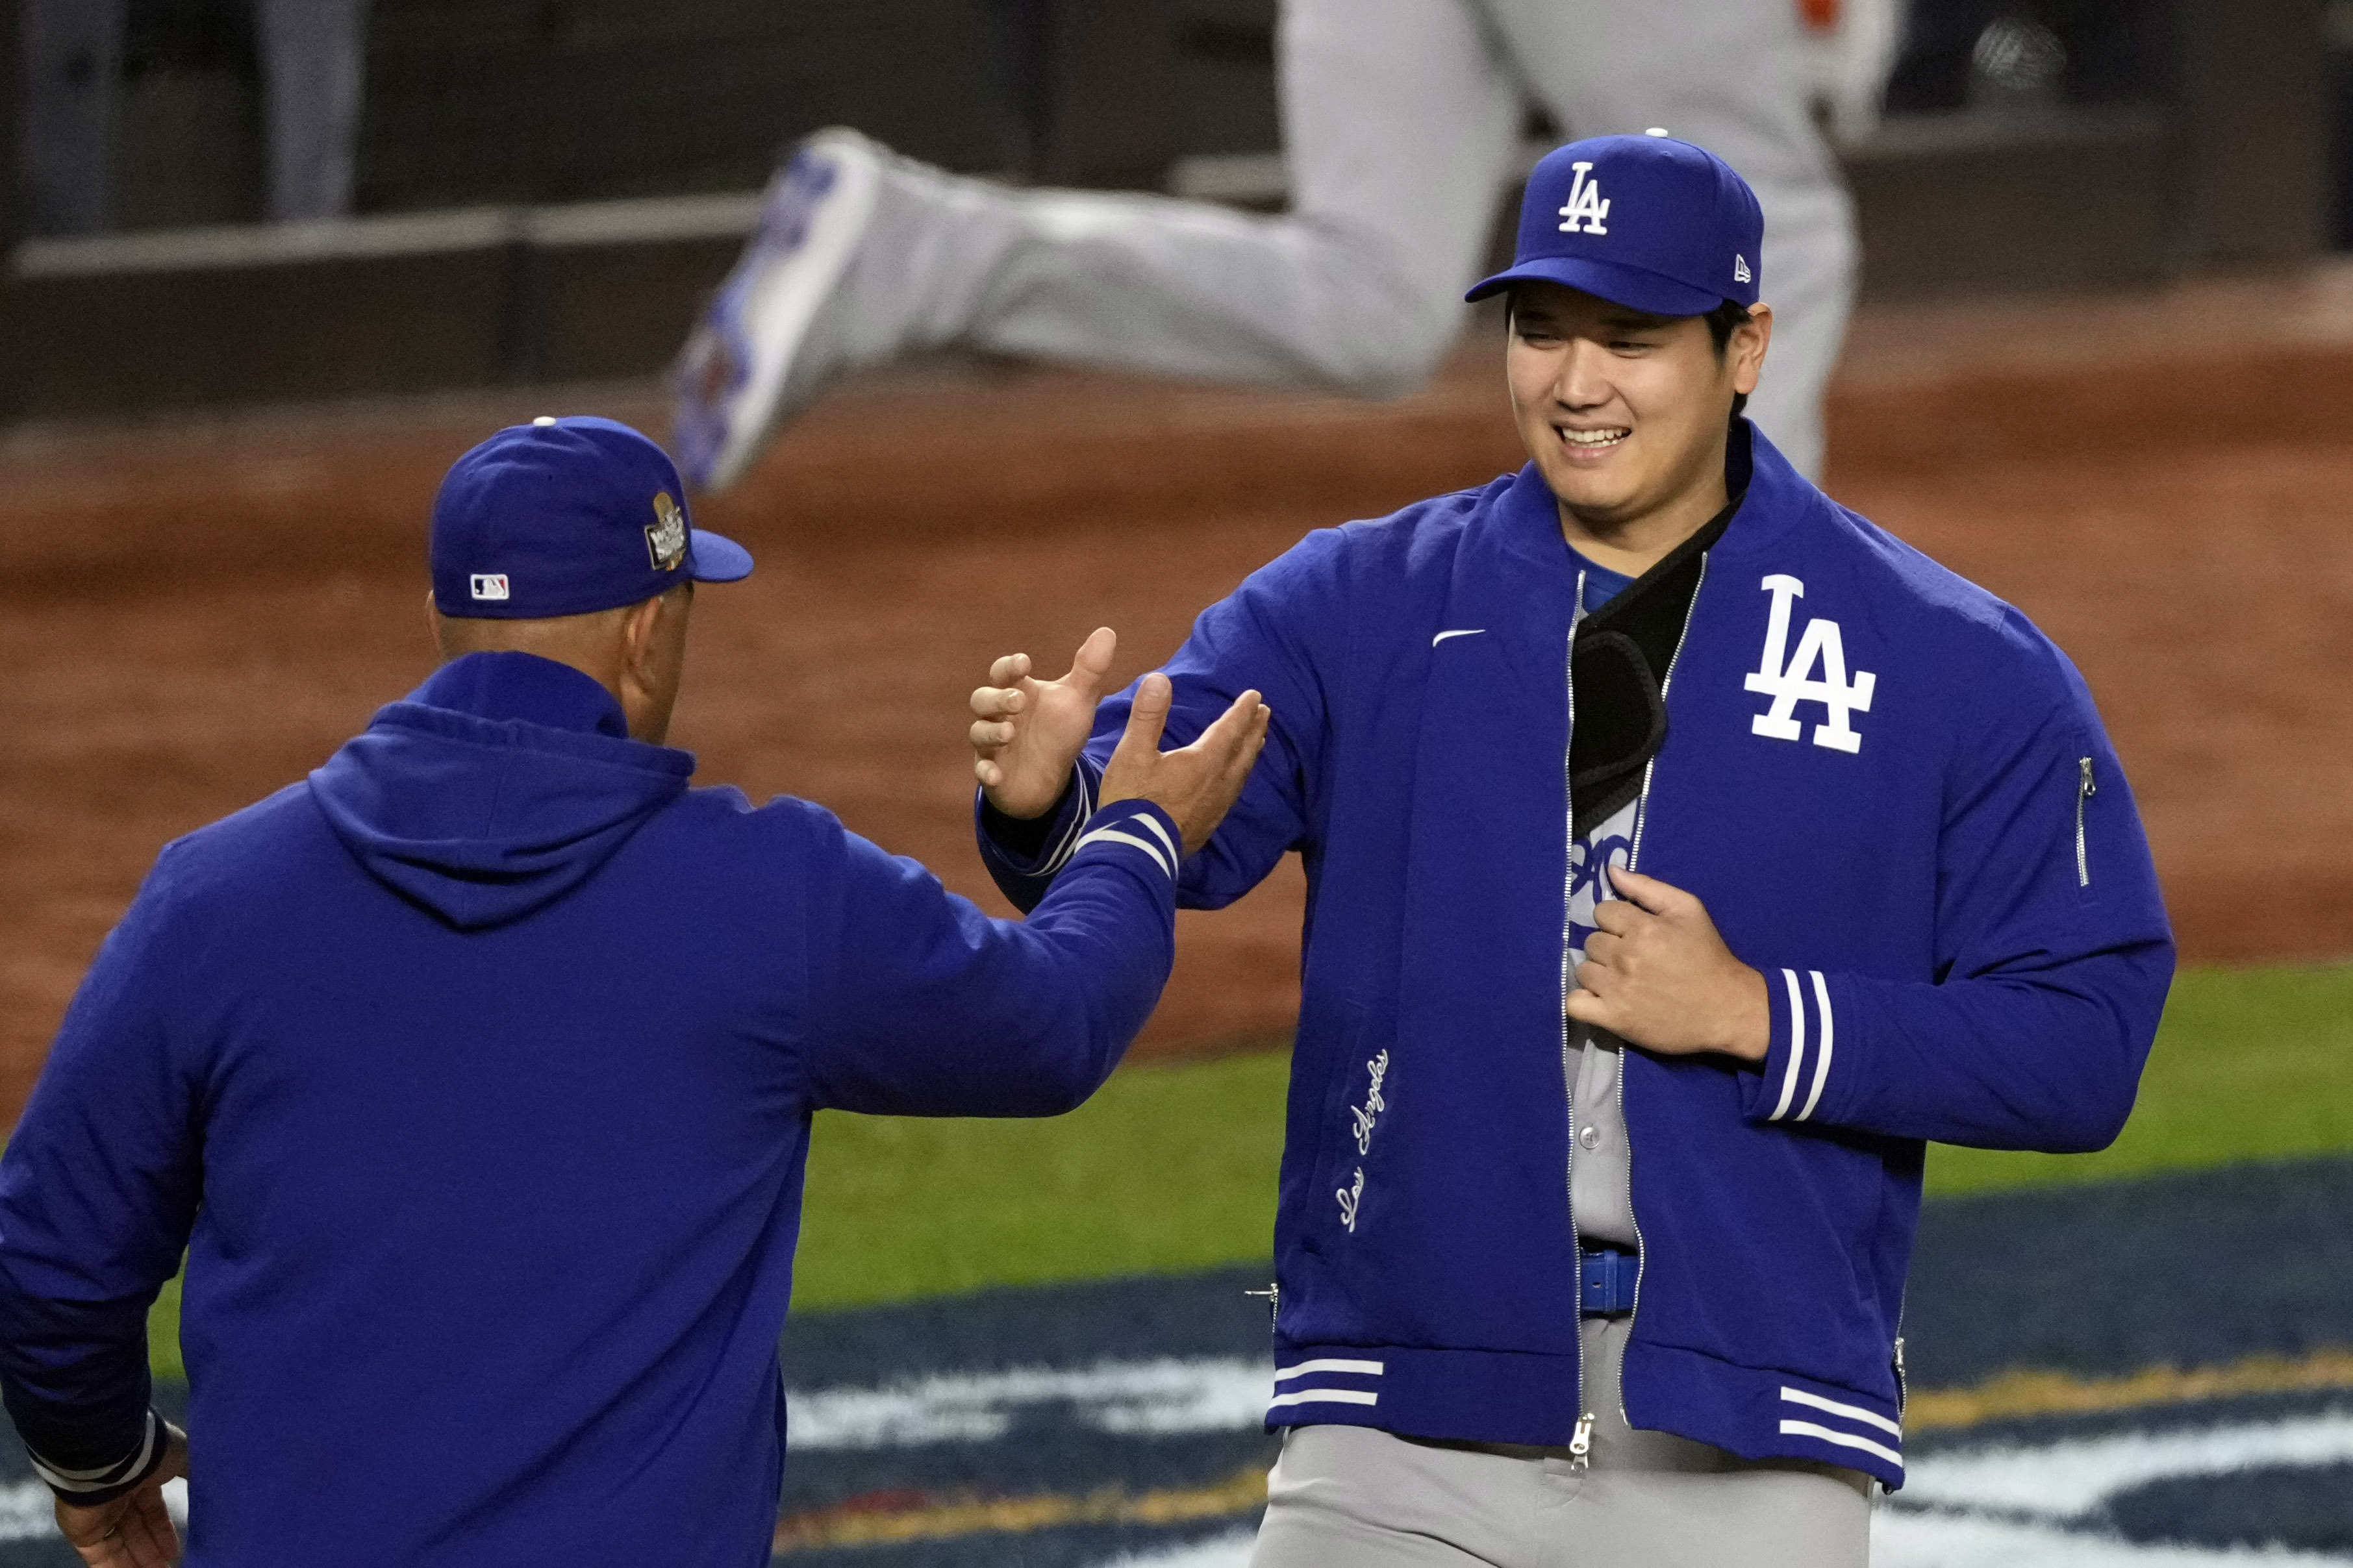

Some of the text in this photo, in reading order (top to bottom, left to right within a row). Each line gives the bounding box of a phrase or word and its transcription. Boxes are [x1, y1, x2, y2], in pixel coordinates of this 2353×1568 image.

[1559, 162, 1611, 236] LA
[1744, 573, 1876, 754] LA
[1335, 1048, 1389, 1233] Los Angeles
